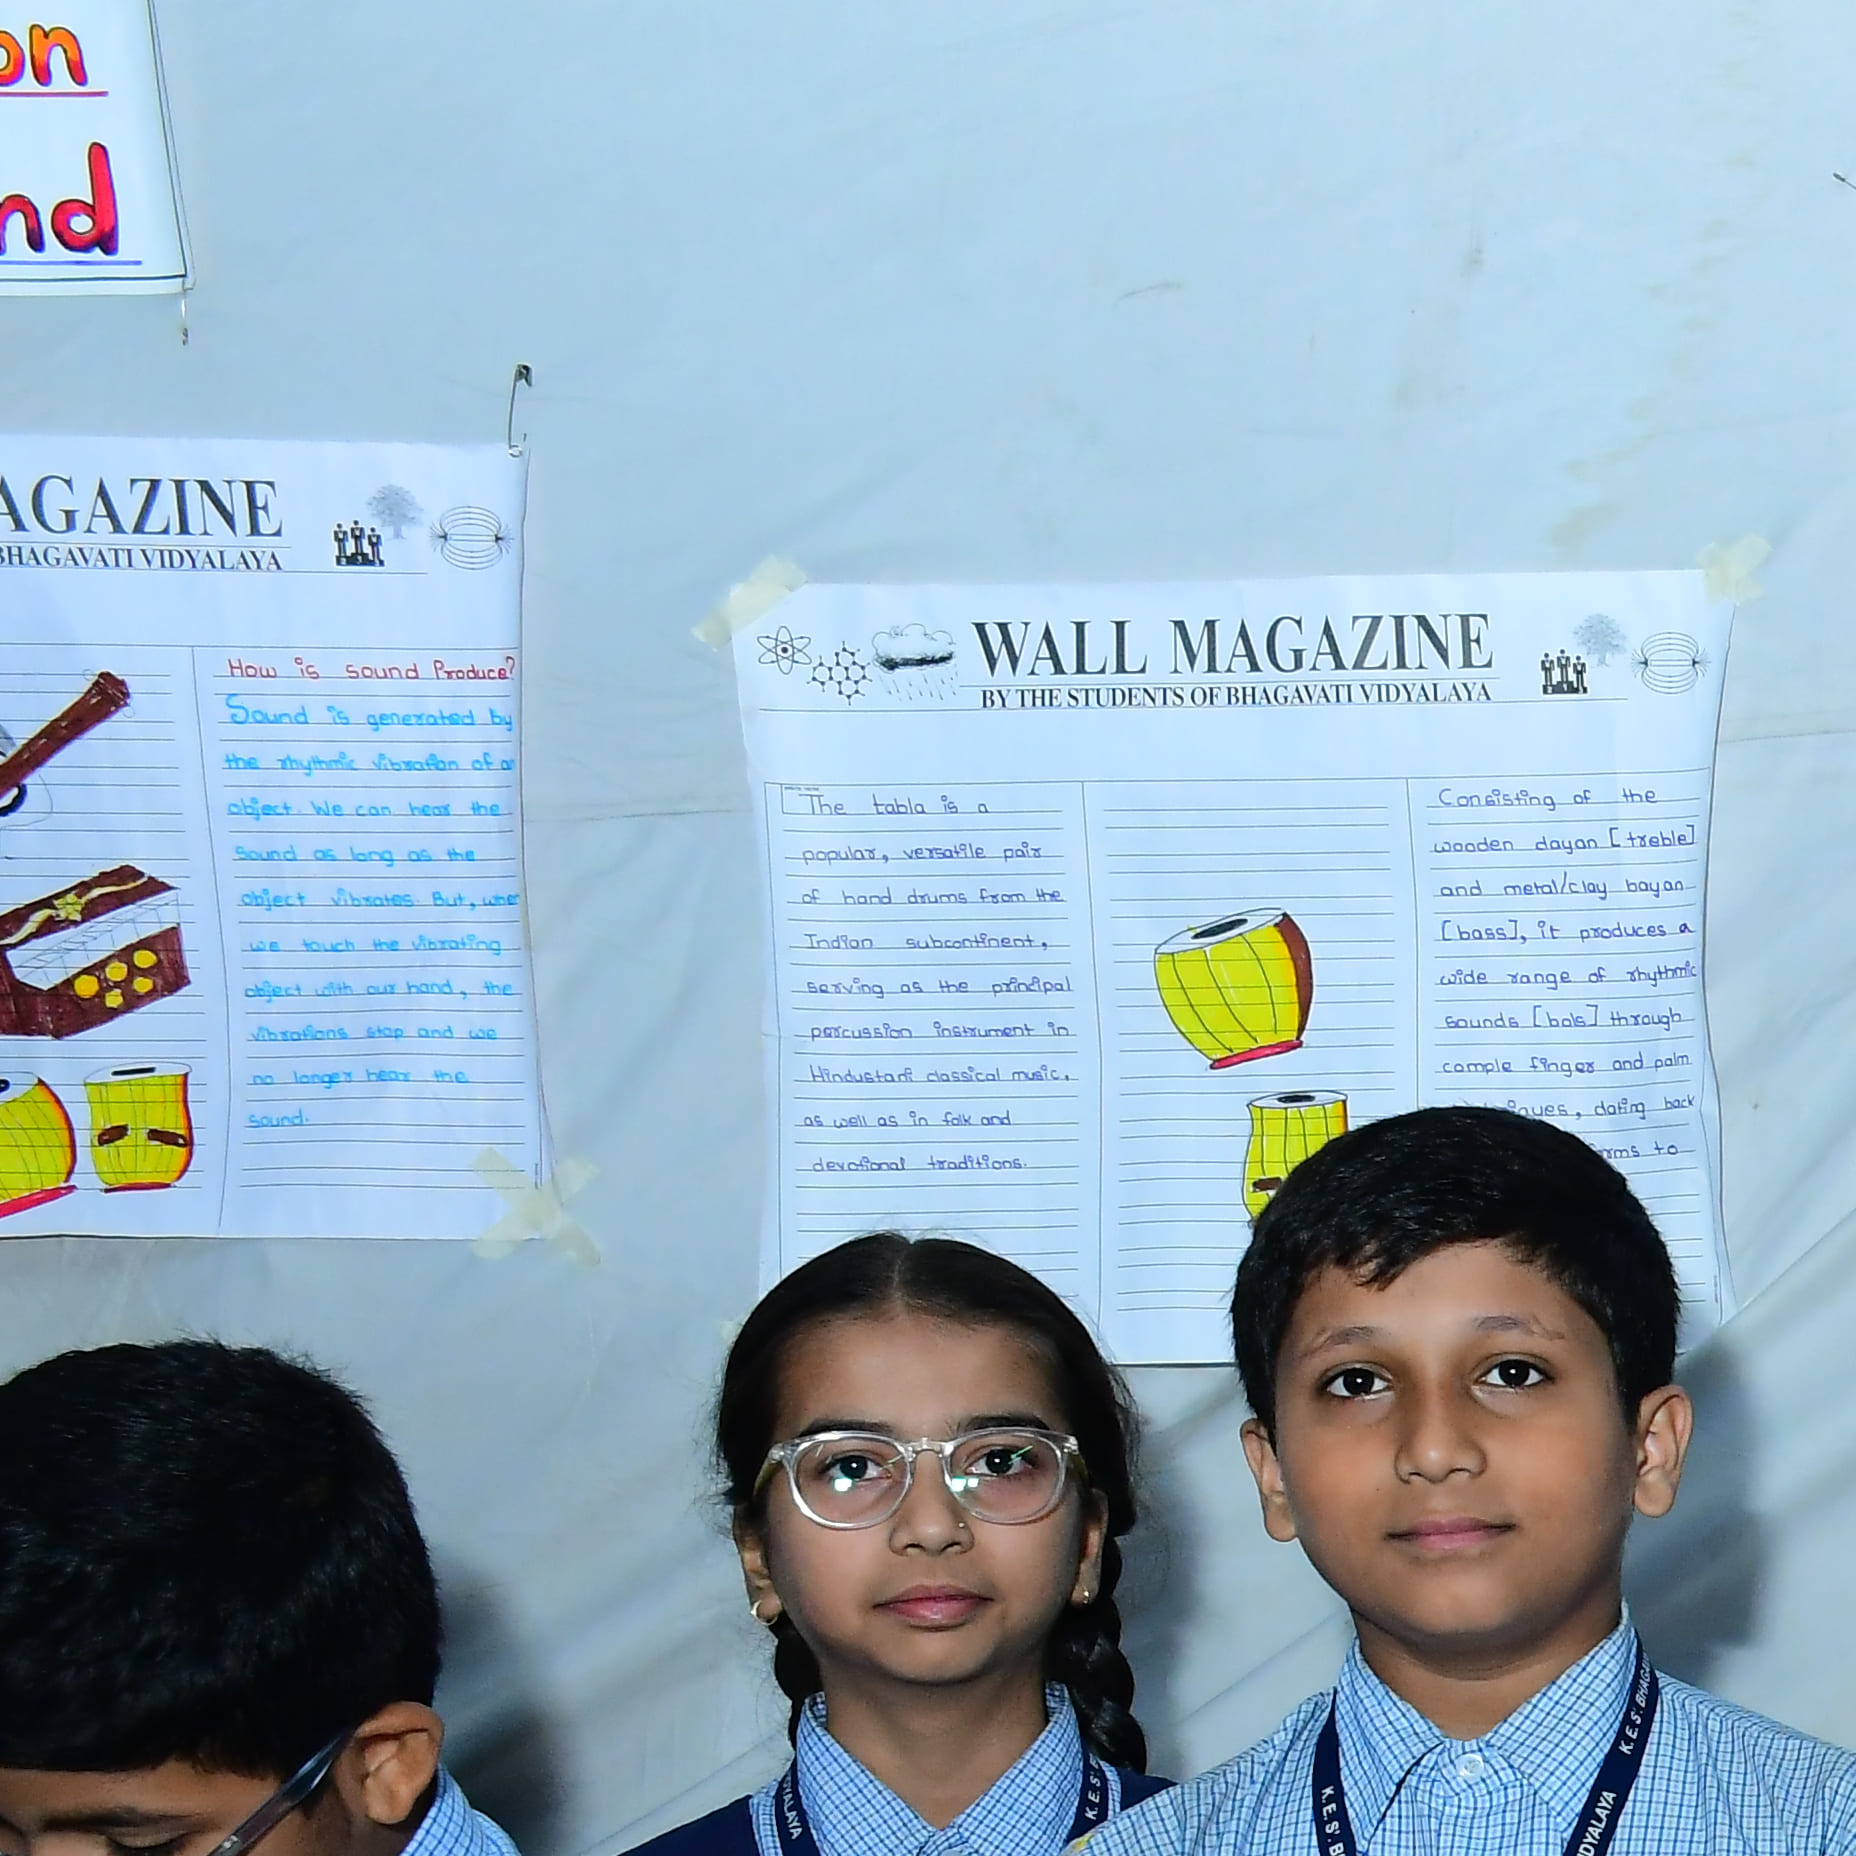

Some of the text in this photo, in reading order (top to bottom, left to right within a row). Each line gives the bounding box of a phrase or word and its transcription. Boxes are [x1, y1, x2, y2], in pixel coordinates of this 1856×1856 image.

[0, 473, 283, 539] AGAZINE
[140, 548, 283, 572] VIDYALAYA
[971, 613, 1494, 678] WALL MAGAZINE
[229, 655, 517, 681] How is sound Produce?
[981, 681, 1492, 708] BY THE STUDENTS OF BHAGAVATI VIDYALAYA
[225, 694, 514, 731] Sound is generated by
[799, 793, 990, 816] The tabla is a
[1438, 787, 1658, 811] Consisting of the
[802, 842, 1042, 866] popular, versatile pair
[1434, 834, 1598, 854] wooden dayan
[802, 887, 1062, 905] of hand drums from the
[1440, 871, 1685, 900] and metal/clay bayan
